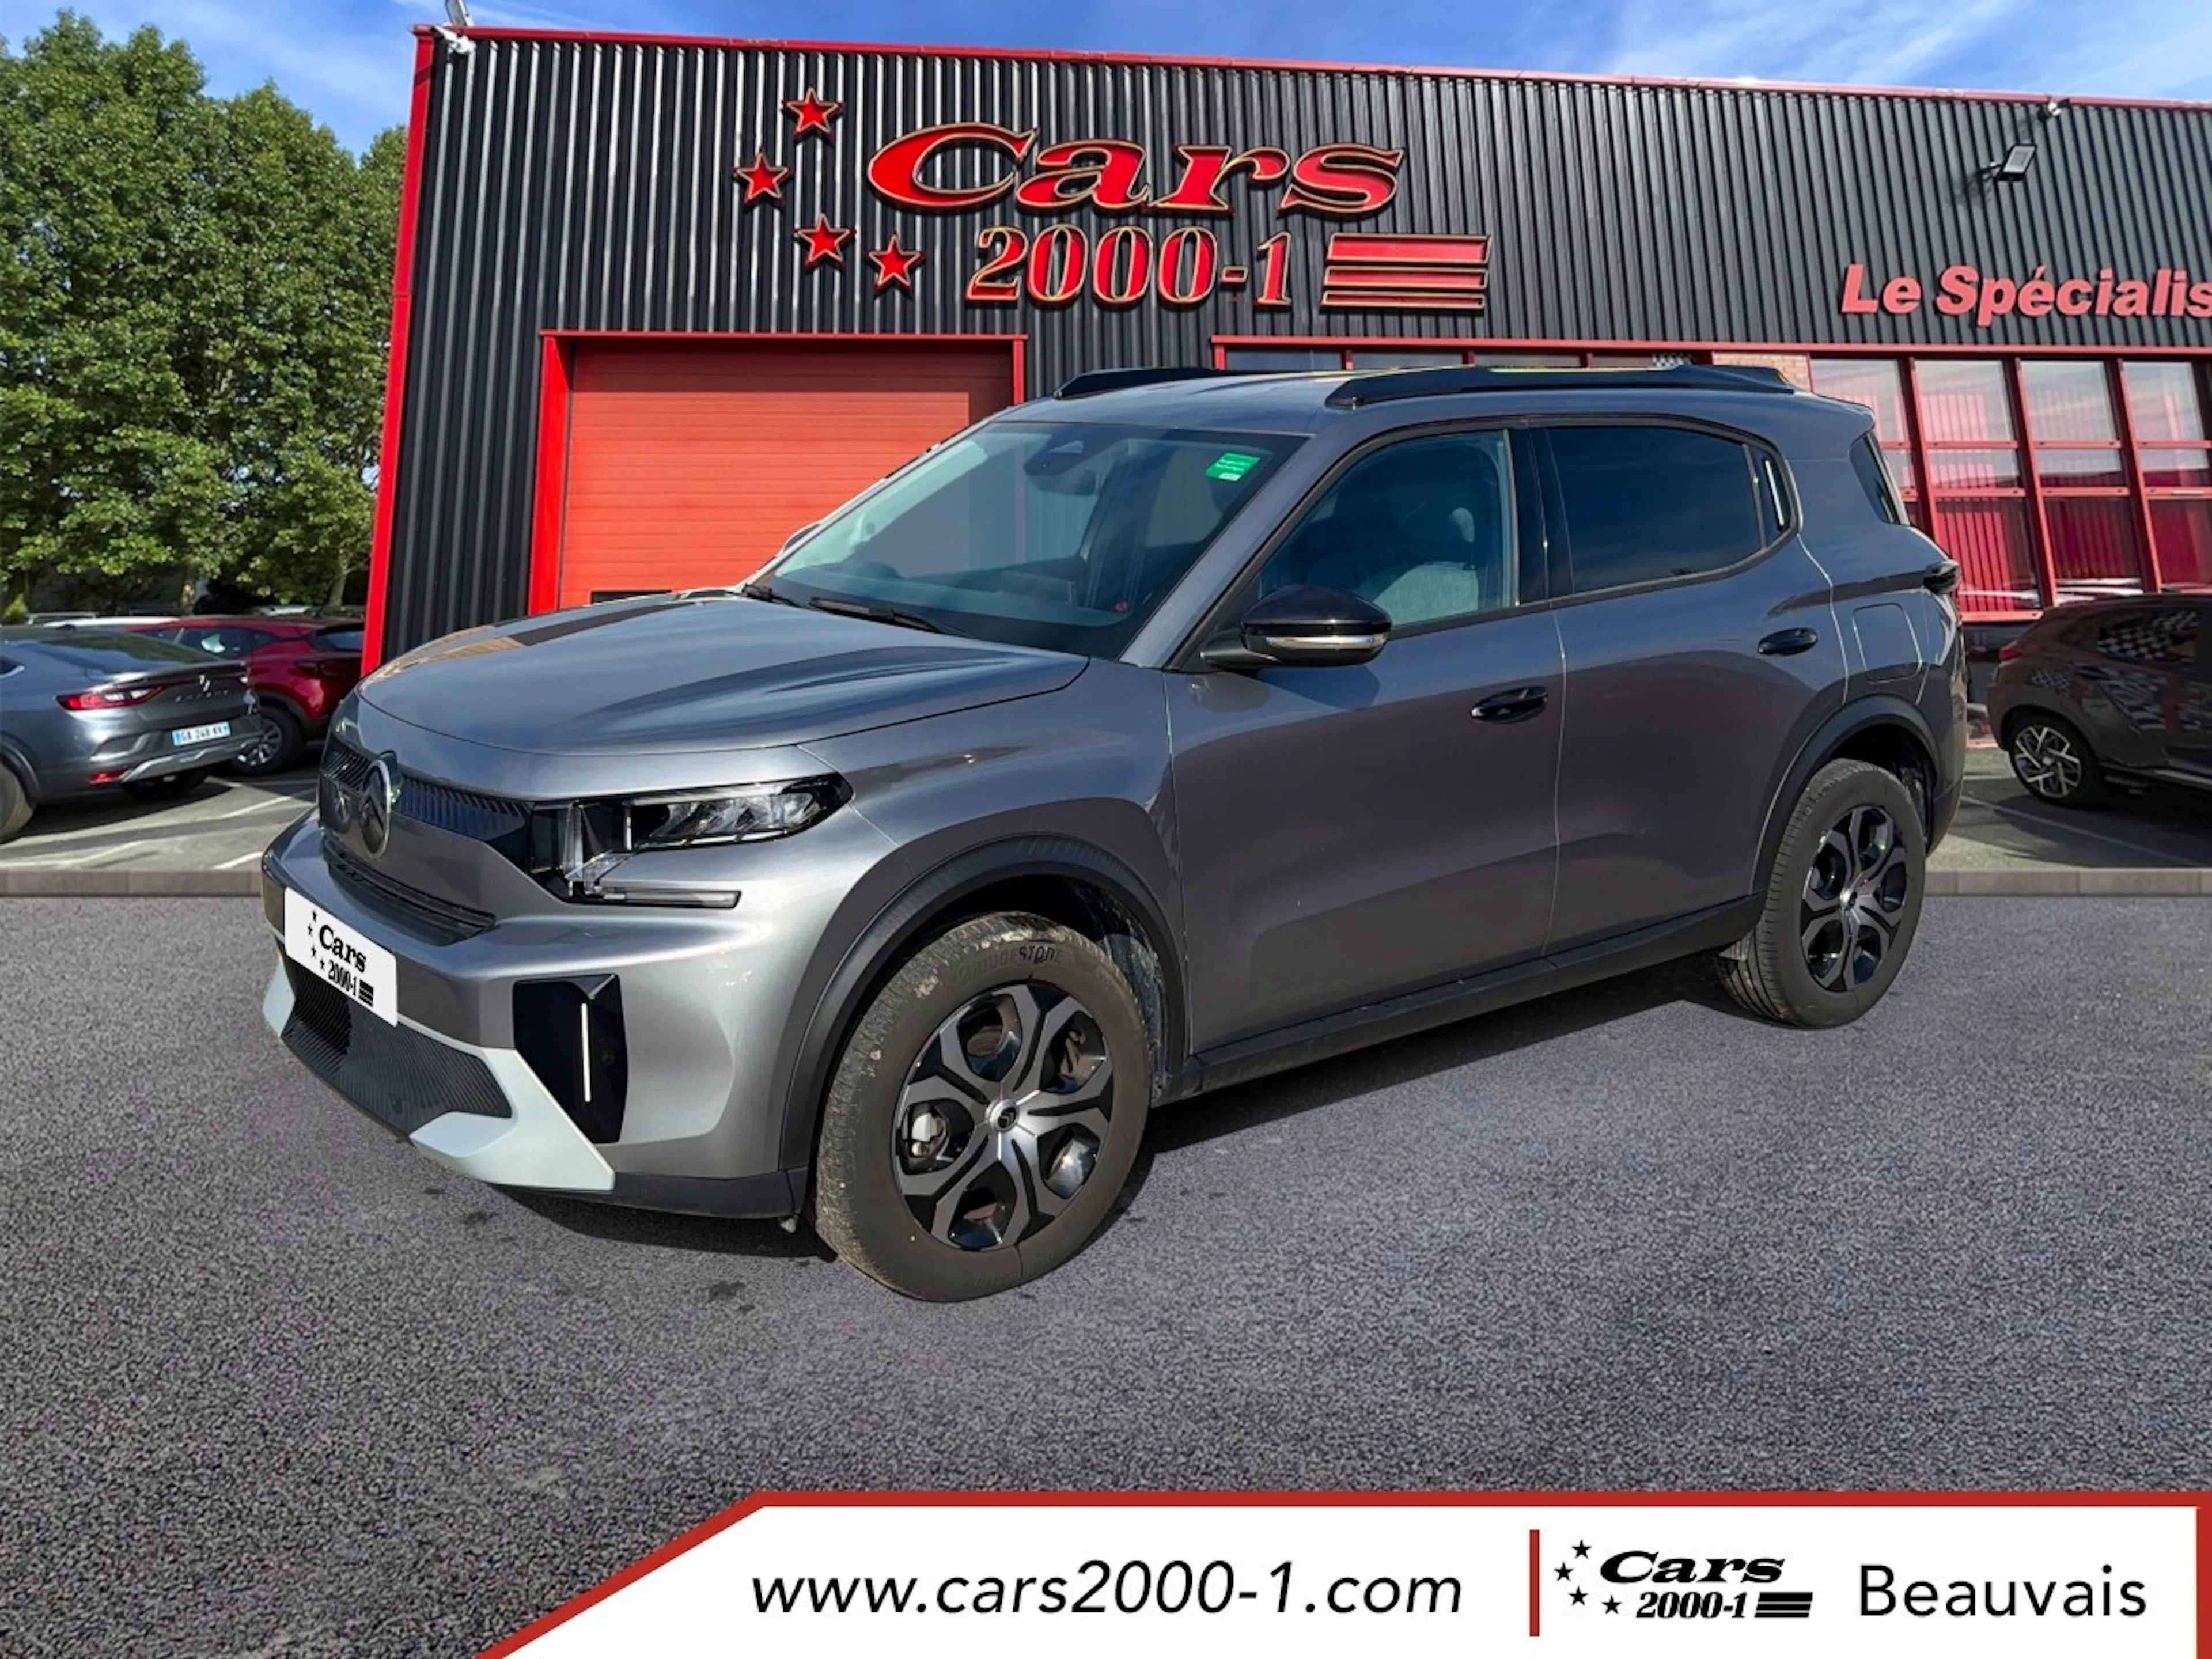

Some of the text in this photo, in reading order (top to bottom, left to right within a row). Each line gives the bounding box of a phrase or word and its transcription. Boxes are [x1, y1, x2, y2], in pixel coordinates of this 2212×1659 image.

[867, 122, 1404, 214] Cars
[966, 225, 1292, 306] 2000-1
[1842, 263, 1922, 314] Le
[319, 925, 368, 973] Cars
